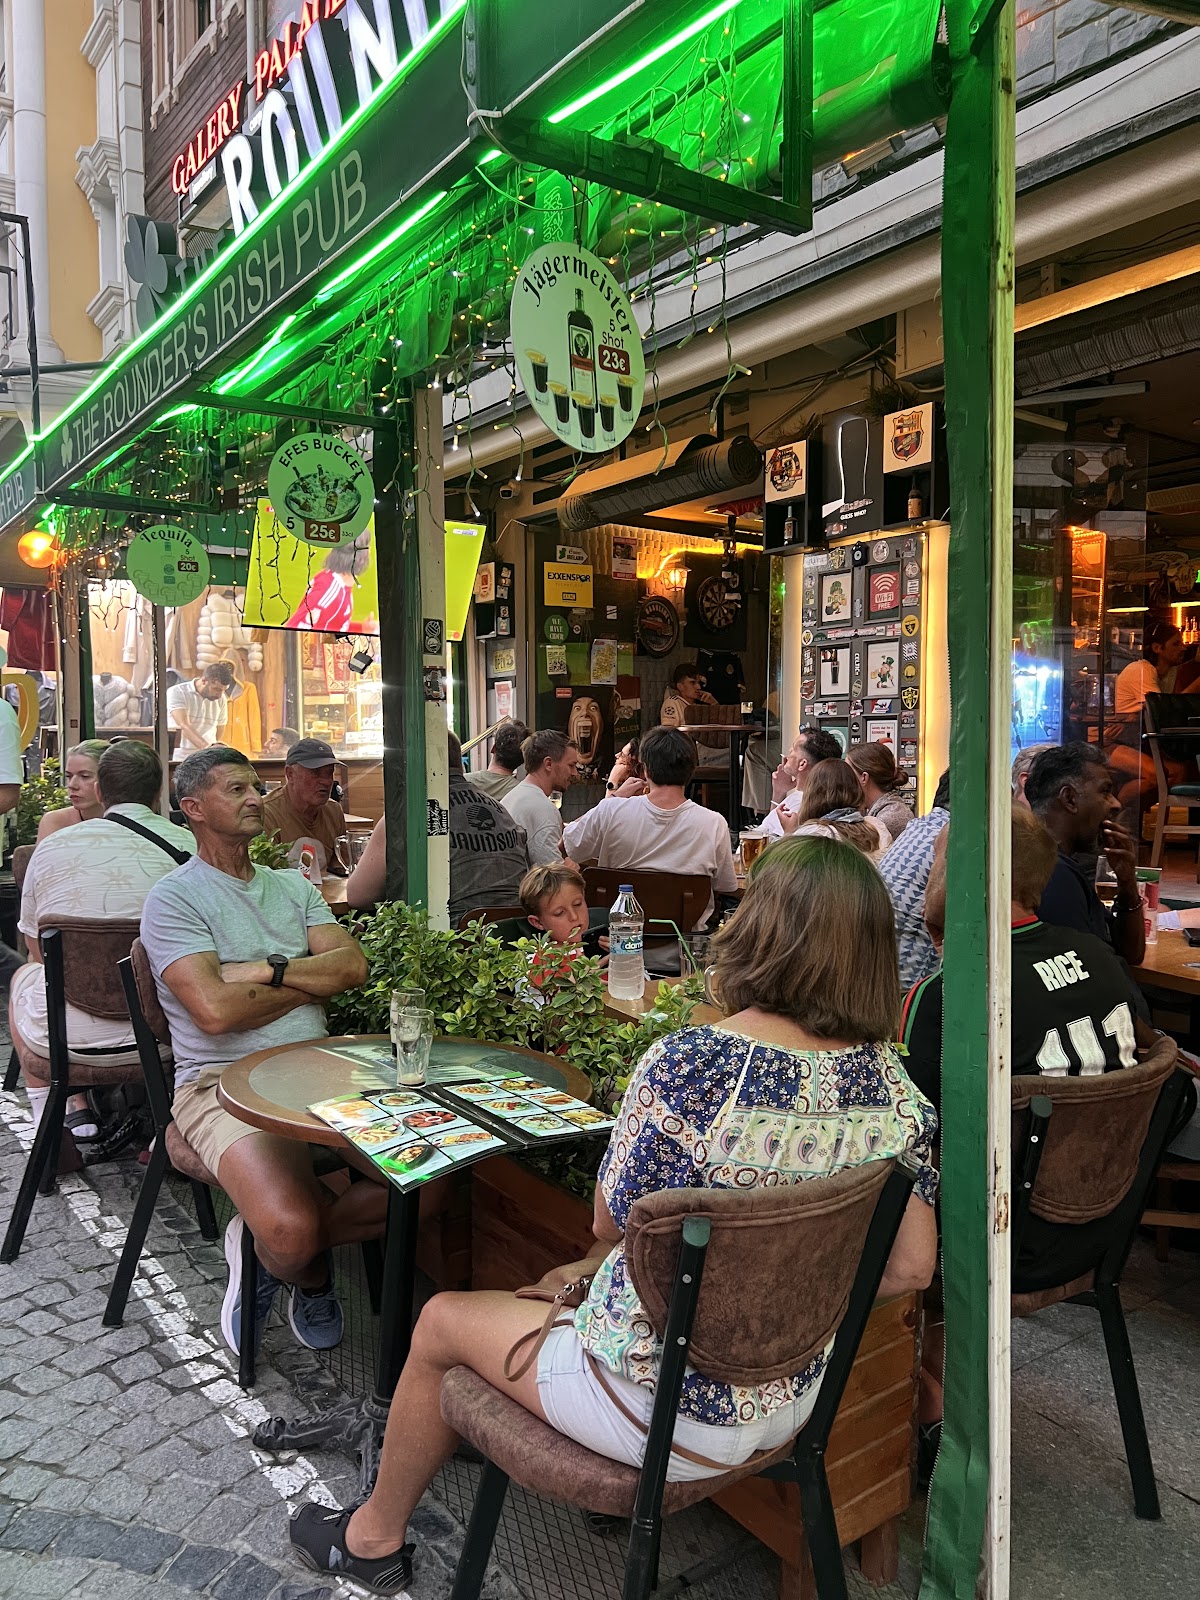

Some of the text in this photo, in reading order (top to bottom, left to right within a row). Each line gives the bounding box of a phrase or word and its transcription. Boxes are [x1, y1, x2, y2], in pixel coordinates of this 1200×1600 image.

[172, 80, 244, 194] GALERY
[522, 255, 632, 334] Jägermeister
[73, 149, 367, 460] THE ROUNDER'S IRISH PUB
[609, 319, 616, 332] 5
[602, 331, 624, 350] Shot
[602, 349, 626, 371] 23€
[278, 438, 365, 478] EFES BUCKET
[286, 516, 295, 530] 5
[309, 523, 336, 540] 25€
[140, 529, 193, 548] Tequila
[180, 554, 195, 562] Shot
[547, 571, 591, 583] EXXENSPOR
[876, 592, 894, 602] Wi-Fi
[877, 602, 891, 610] FREE
[1032, 950, 1091, 992] RICE
